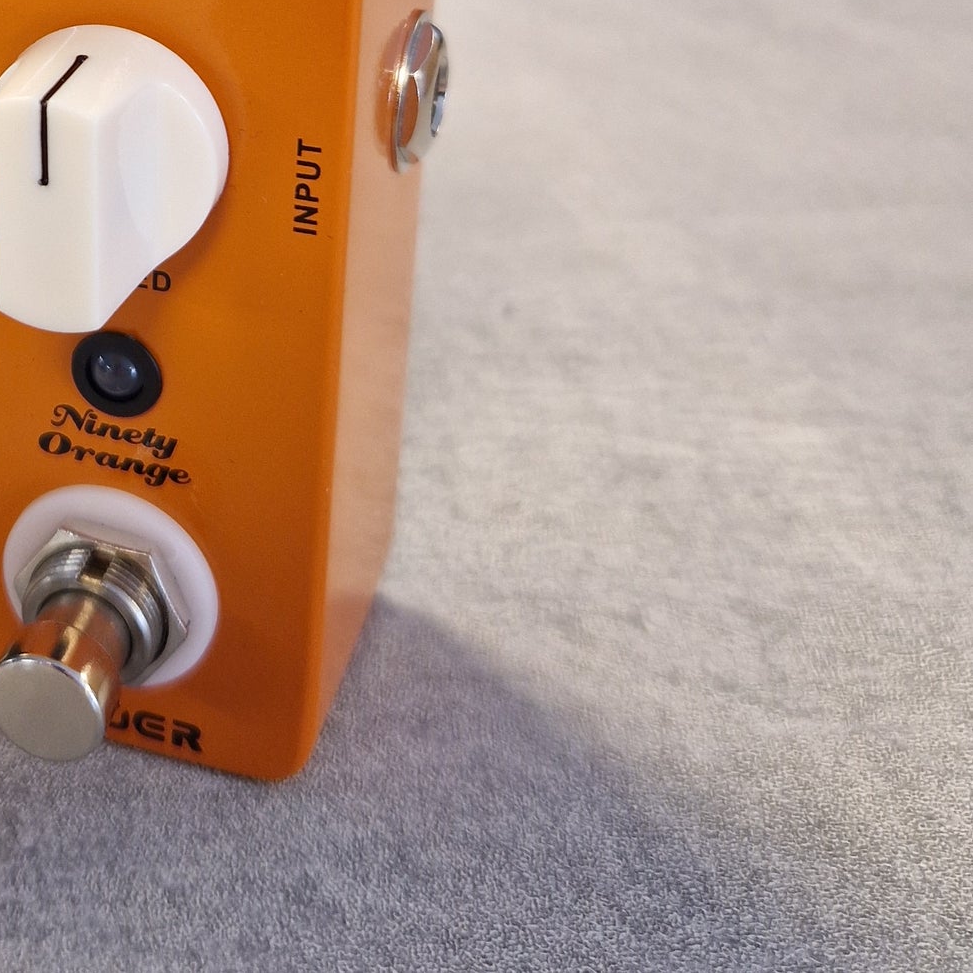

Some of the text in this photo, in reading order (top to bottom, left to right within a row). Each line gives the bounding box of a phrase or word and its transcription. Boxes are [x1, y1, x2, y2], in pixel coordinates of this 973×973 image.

[293, 138, 322, 236] INPUT
[38, 431, 192, 487] Orange
[50, 404, 178, 460] Ninety
